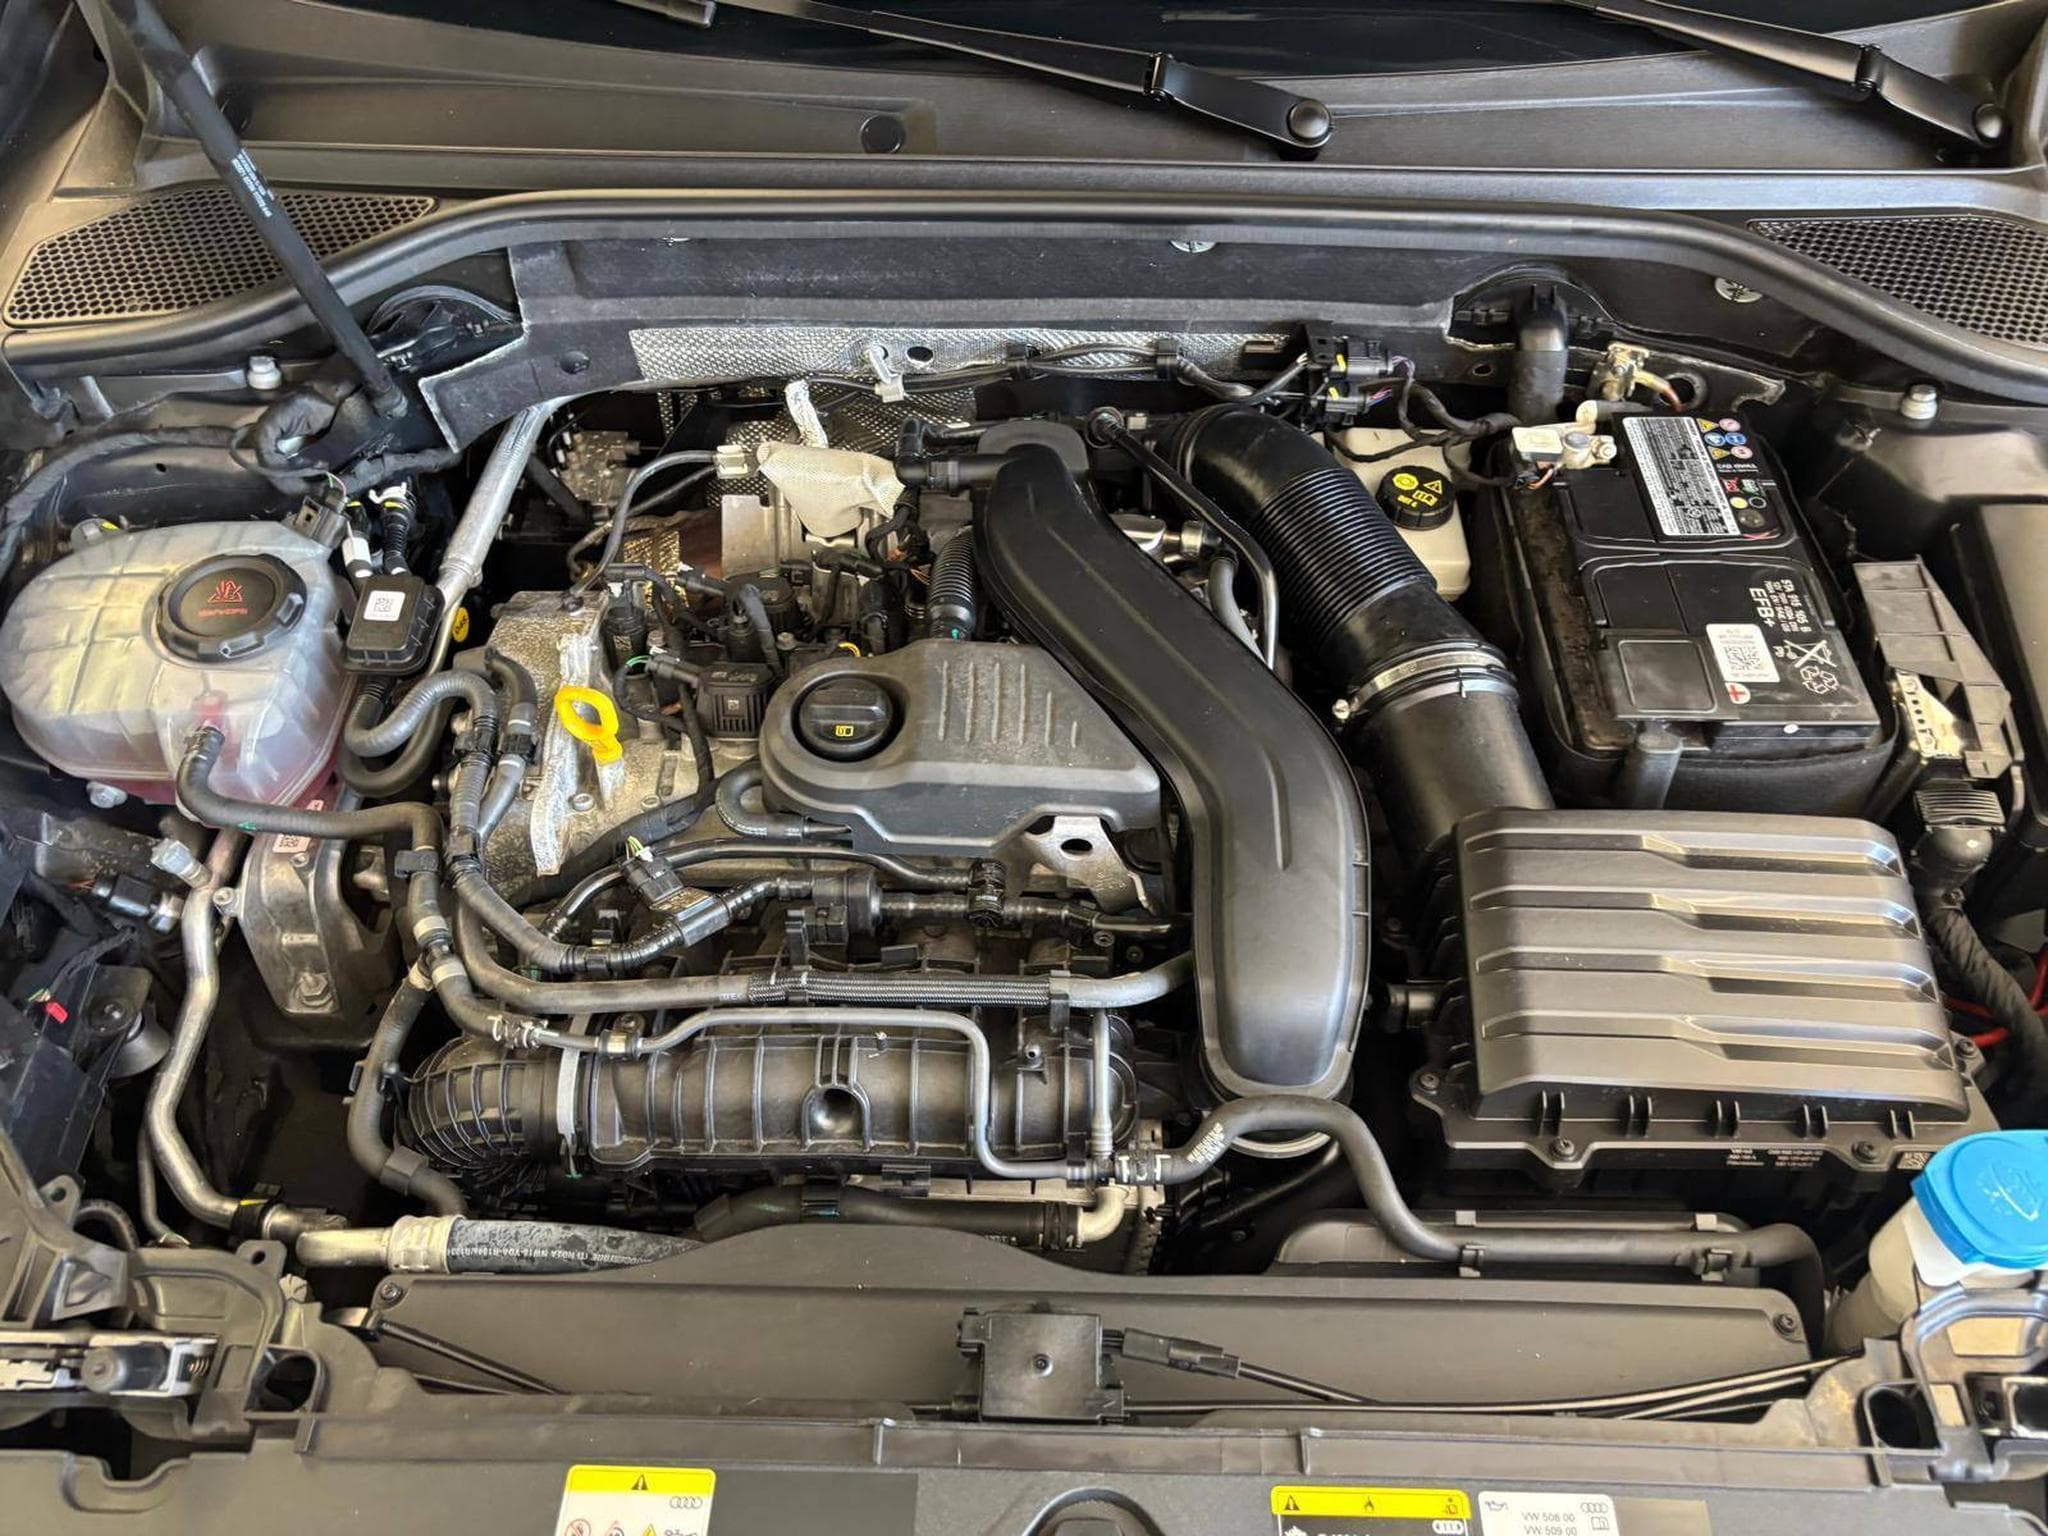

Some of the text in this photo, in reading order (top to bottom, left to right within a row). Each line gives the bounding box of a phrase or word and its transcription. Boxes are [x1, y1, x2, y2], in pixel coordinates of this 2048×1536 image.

[1749, 587, 1775, 628] EFB+
[1521, 1512, 1540, 1521] VW
[1563, 1513, 1576, 1522] 00
[1524, 1525, 1577, 1536] VW 509 00
